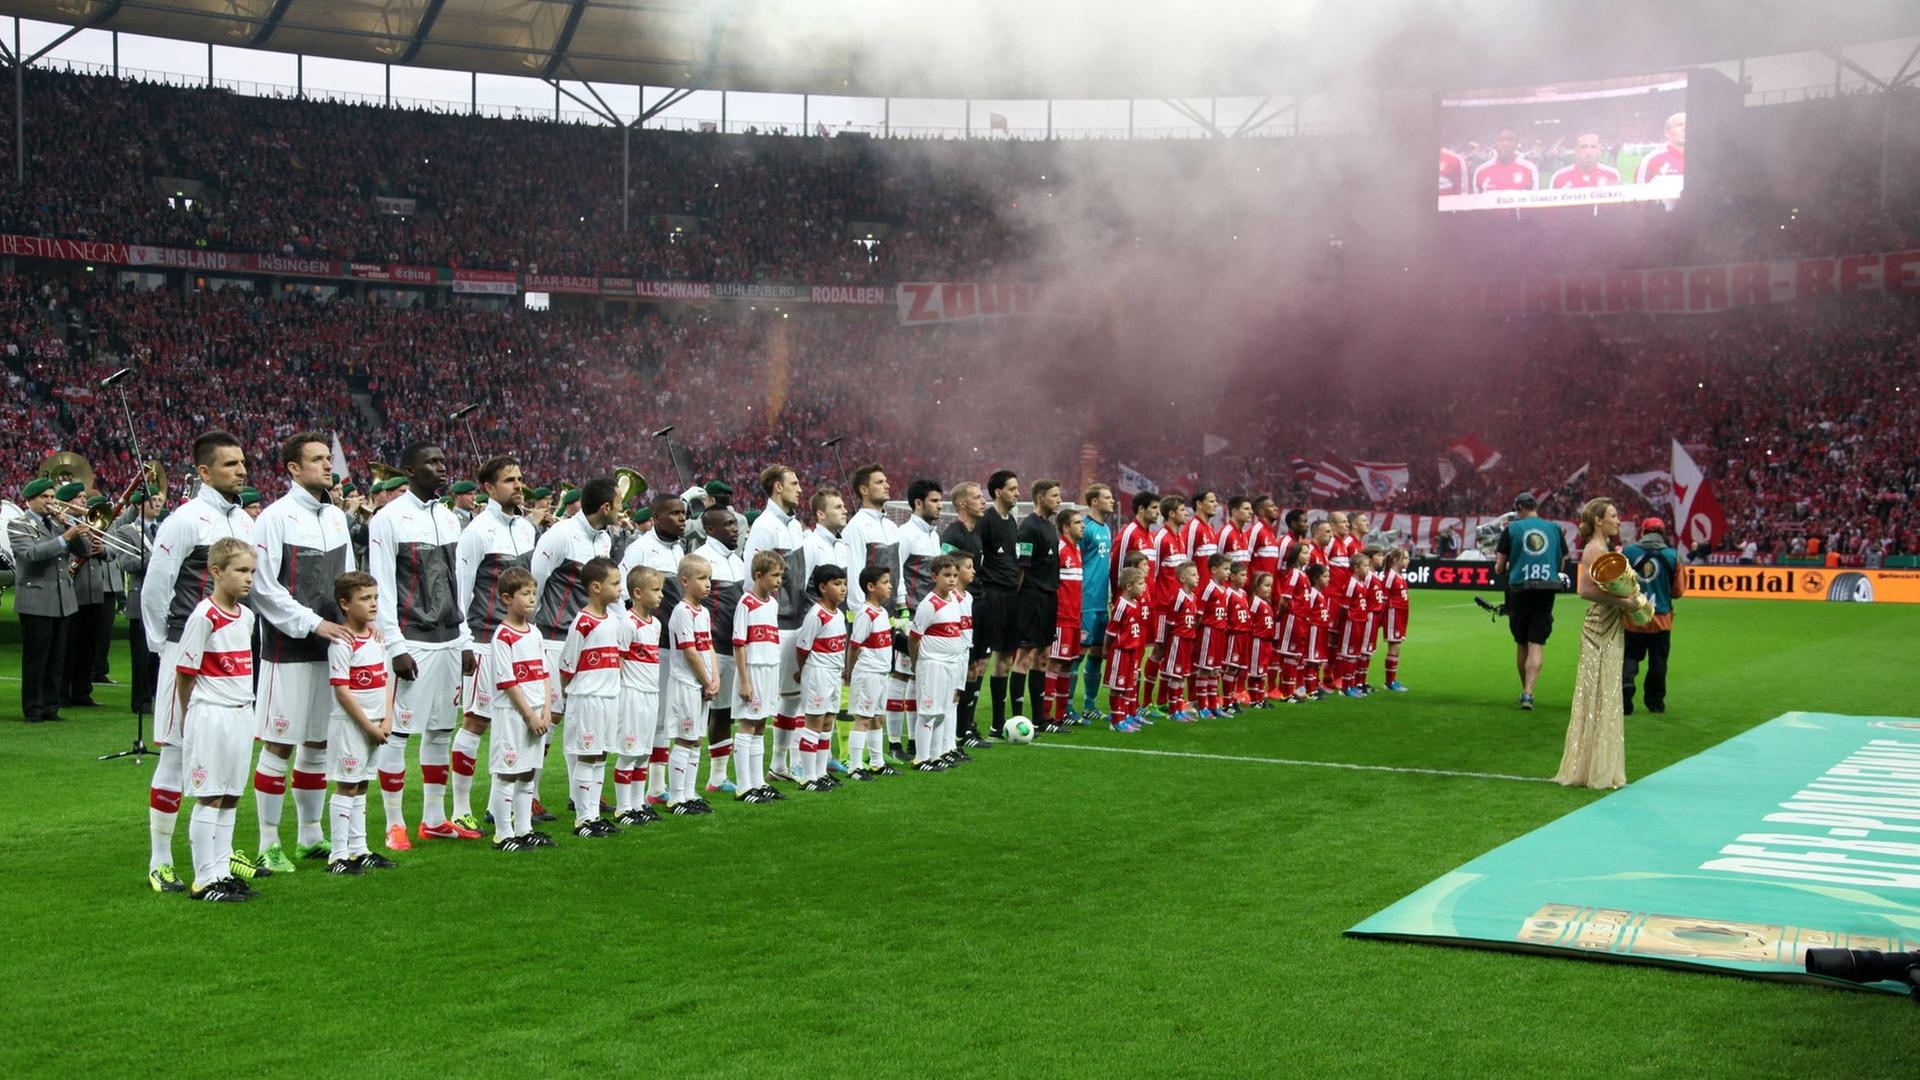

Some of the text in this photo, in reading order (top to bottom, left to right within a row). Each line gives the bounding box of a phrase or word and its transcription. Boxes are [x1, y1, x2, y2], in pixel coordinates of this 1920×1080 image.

[2, 234, 131, 264] BESTIA NEGRA
[157, 247, 227, 270] EMSLAND
[395, 267, 431, 281] Eching
[524, 274, 599, 288] BAAR-BAZIS
[636, 281, 710, 298] ILLSCHWANG
[812, 286, 884, 304] RODALBEN
[1402, 566, 1430, 583] olf
[1522, 564, 1550, 581] 185
[1687, 569, 1795, 593] inental
